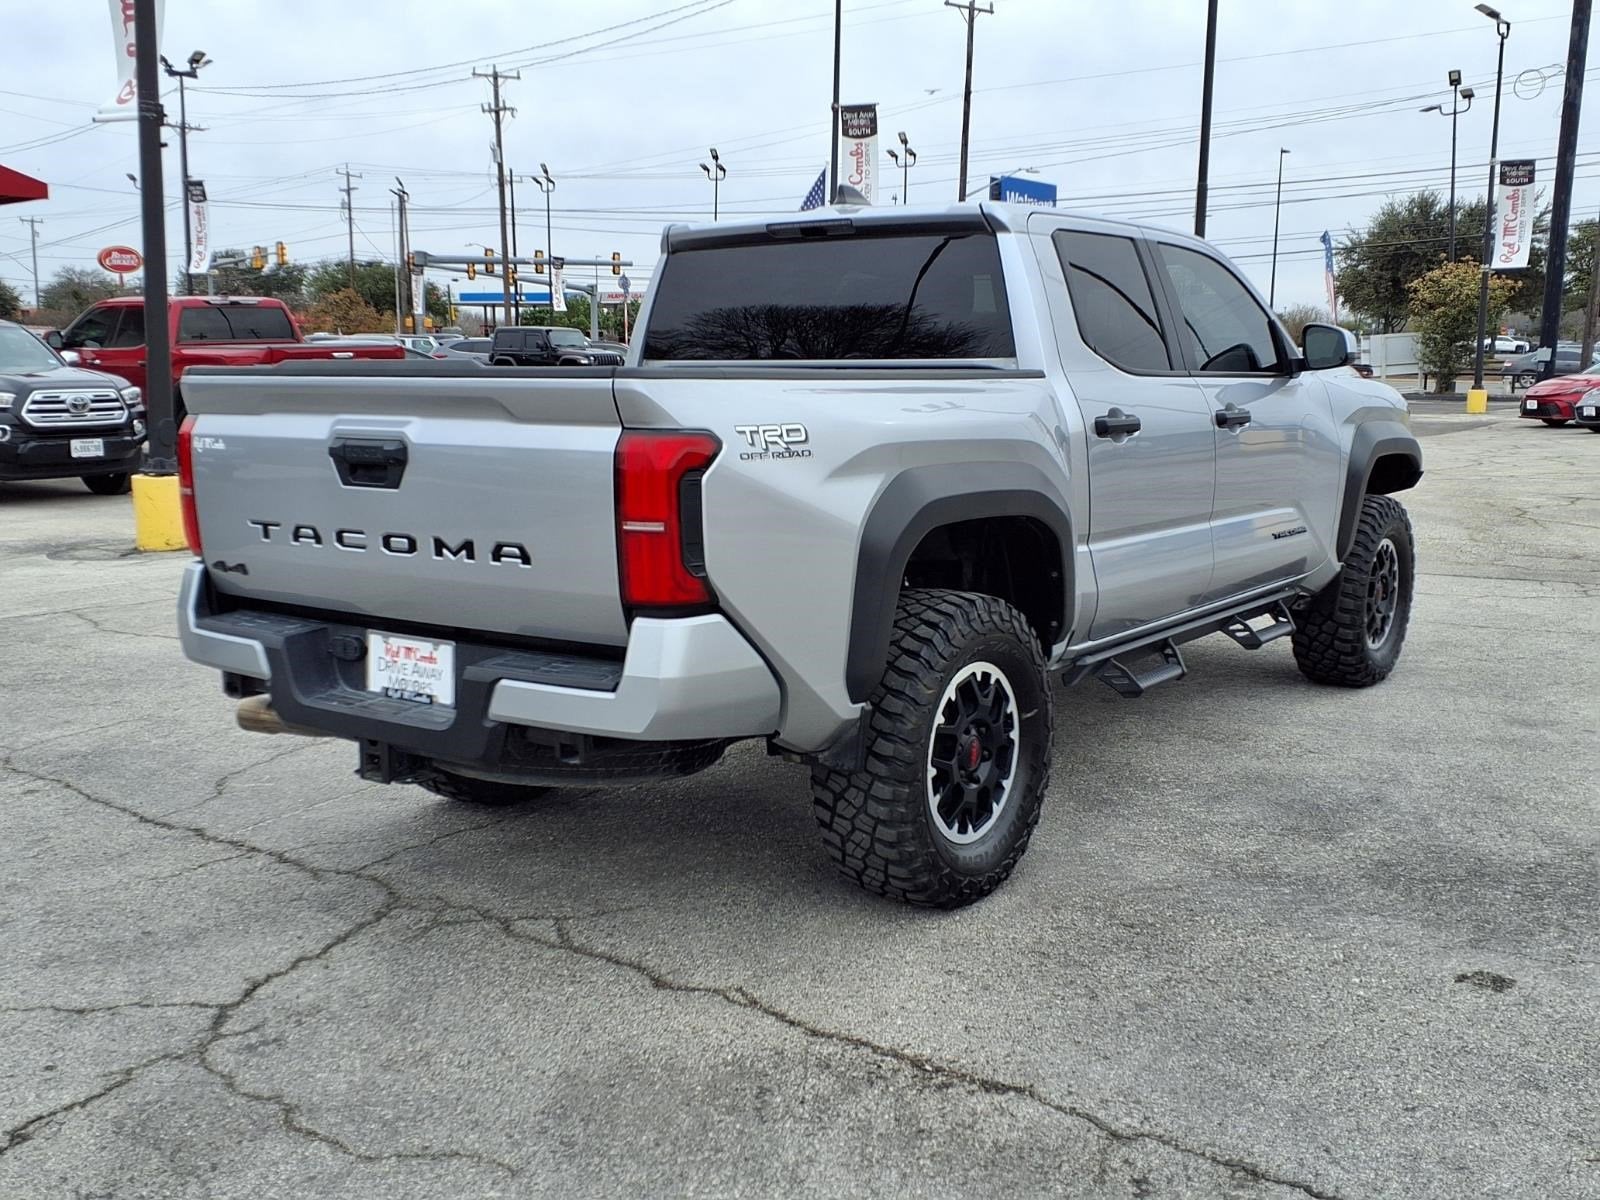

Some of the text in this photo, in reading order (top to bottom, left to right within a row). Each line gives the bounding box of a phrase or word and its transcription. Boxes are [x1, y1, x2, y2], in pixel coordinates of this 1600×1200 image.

[848, 127, 871, 136] SOUTH
[1499, 188, 1520, 264] Red McCombs
[734, 423, 809, 451] TRD
[739, 449, 812, 461] OFF ROAD
[247, 518, 533, 569] TACOMA
[384, 642, 402, 663] Red
[377, 656, 444, 681] DRIVE AWAY
[387, 675, 433, 694] MOTORS
